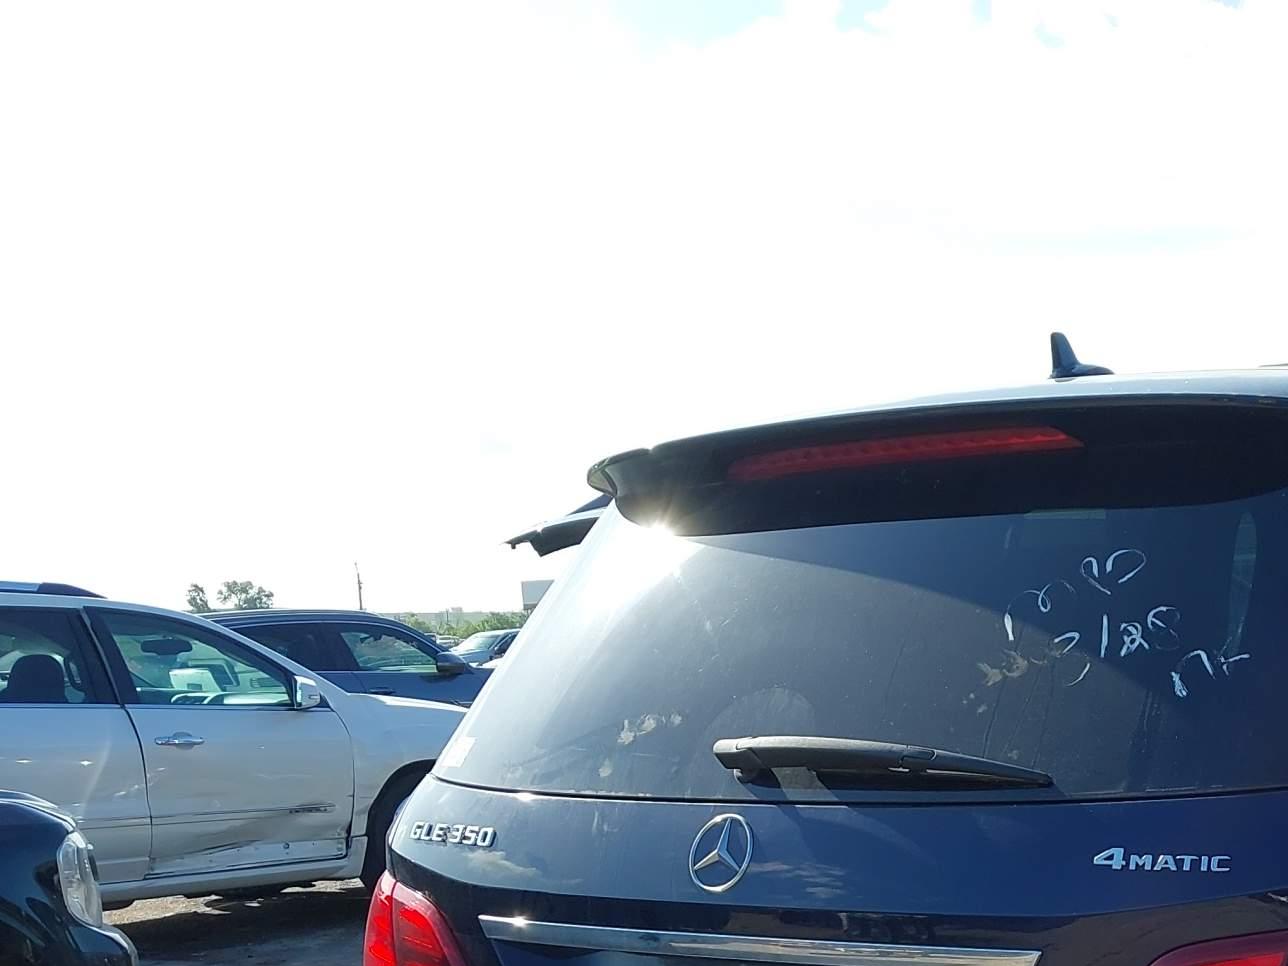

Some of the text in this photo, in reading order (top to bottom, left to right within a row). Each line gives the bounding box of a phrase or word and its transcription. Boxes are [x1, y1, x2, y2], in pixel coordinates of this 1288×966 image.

[410, 821, 496, 847] GLE 350
[1093, 847, 1231, 872] 4MATIC
